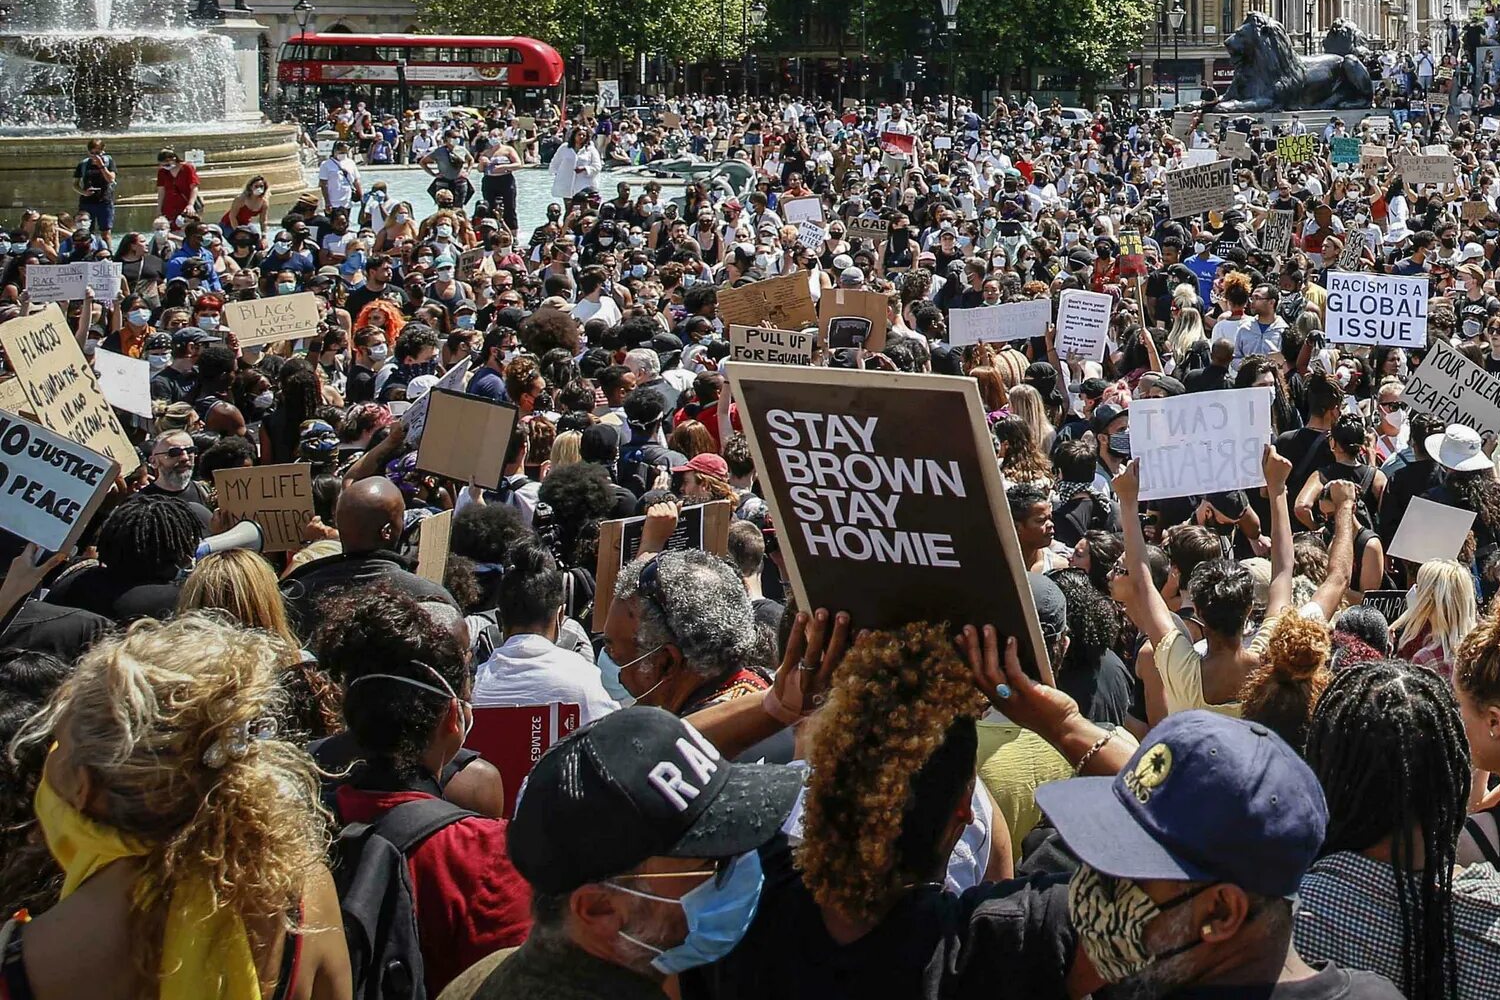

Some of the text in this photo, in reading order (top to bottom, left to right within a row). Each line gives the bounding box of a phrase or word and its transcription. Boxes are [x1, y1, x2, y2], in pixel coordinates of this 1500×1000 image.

[1278, 136, 1312, 148] BLACK
[1280, 145, 1312, 155] LIVES
[1179, 168, 1230, 189] INNOCENT
[802, 222, 818, 232] BLACK
[850, 219, 887, 231] ACAB
[33, 277, 54, 285] BLACK
[1332, 279, 1422, 296] RACISM IS A
[239, 301, 295, 320] BLACK
[1327, 293, 1426, 318] GLOBAL
[255, 320, 313, 337] MATTER
[260, 314, 295, 326] LIVES
[1339, 317, 1412, 341] ISSUE
[746, 329, 807, 349] PULL UP
[15, 334, 37, 368] HI
[734, 345, 766, 362] FOR
[1430, 343, 1466, 381] YOUR
[39, 373, 57, 406] JUMP
[62, 363, 79, 386] THE
[1448, 382, 1465, 399] IS
[60, 392, 87, 426] AIR AND
[765, 408, 879, 453] STAY
[28, 437, 104, 487] JUSTICE
[776, 447, 967, 498] BROWN
[224, 473, 305, 501] MY LIFE
[7, 474, 82, 526] PEACE
[789, 484, 901, 529] STAY
[800, 521, 962, 568] HOMIE
